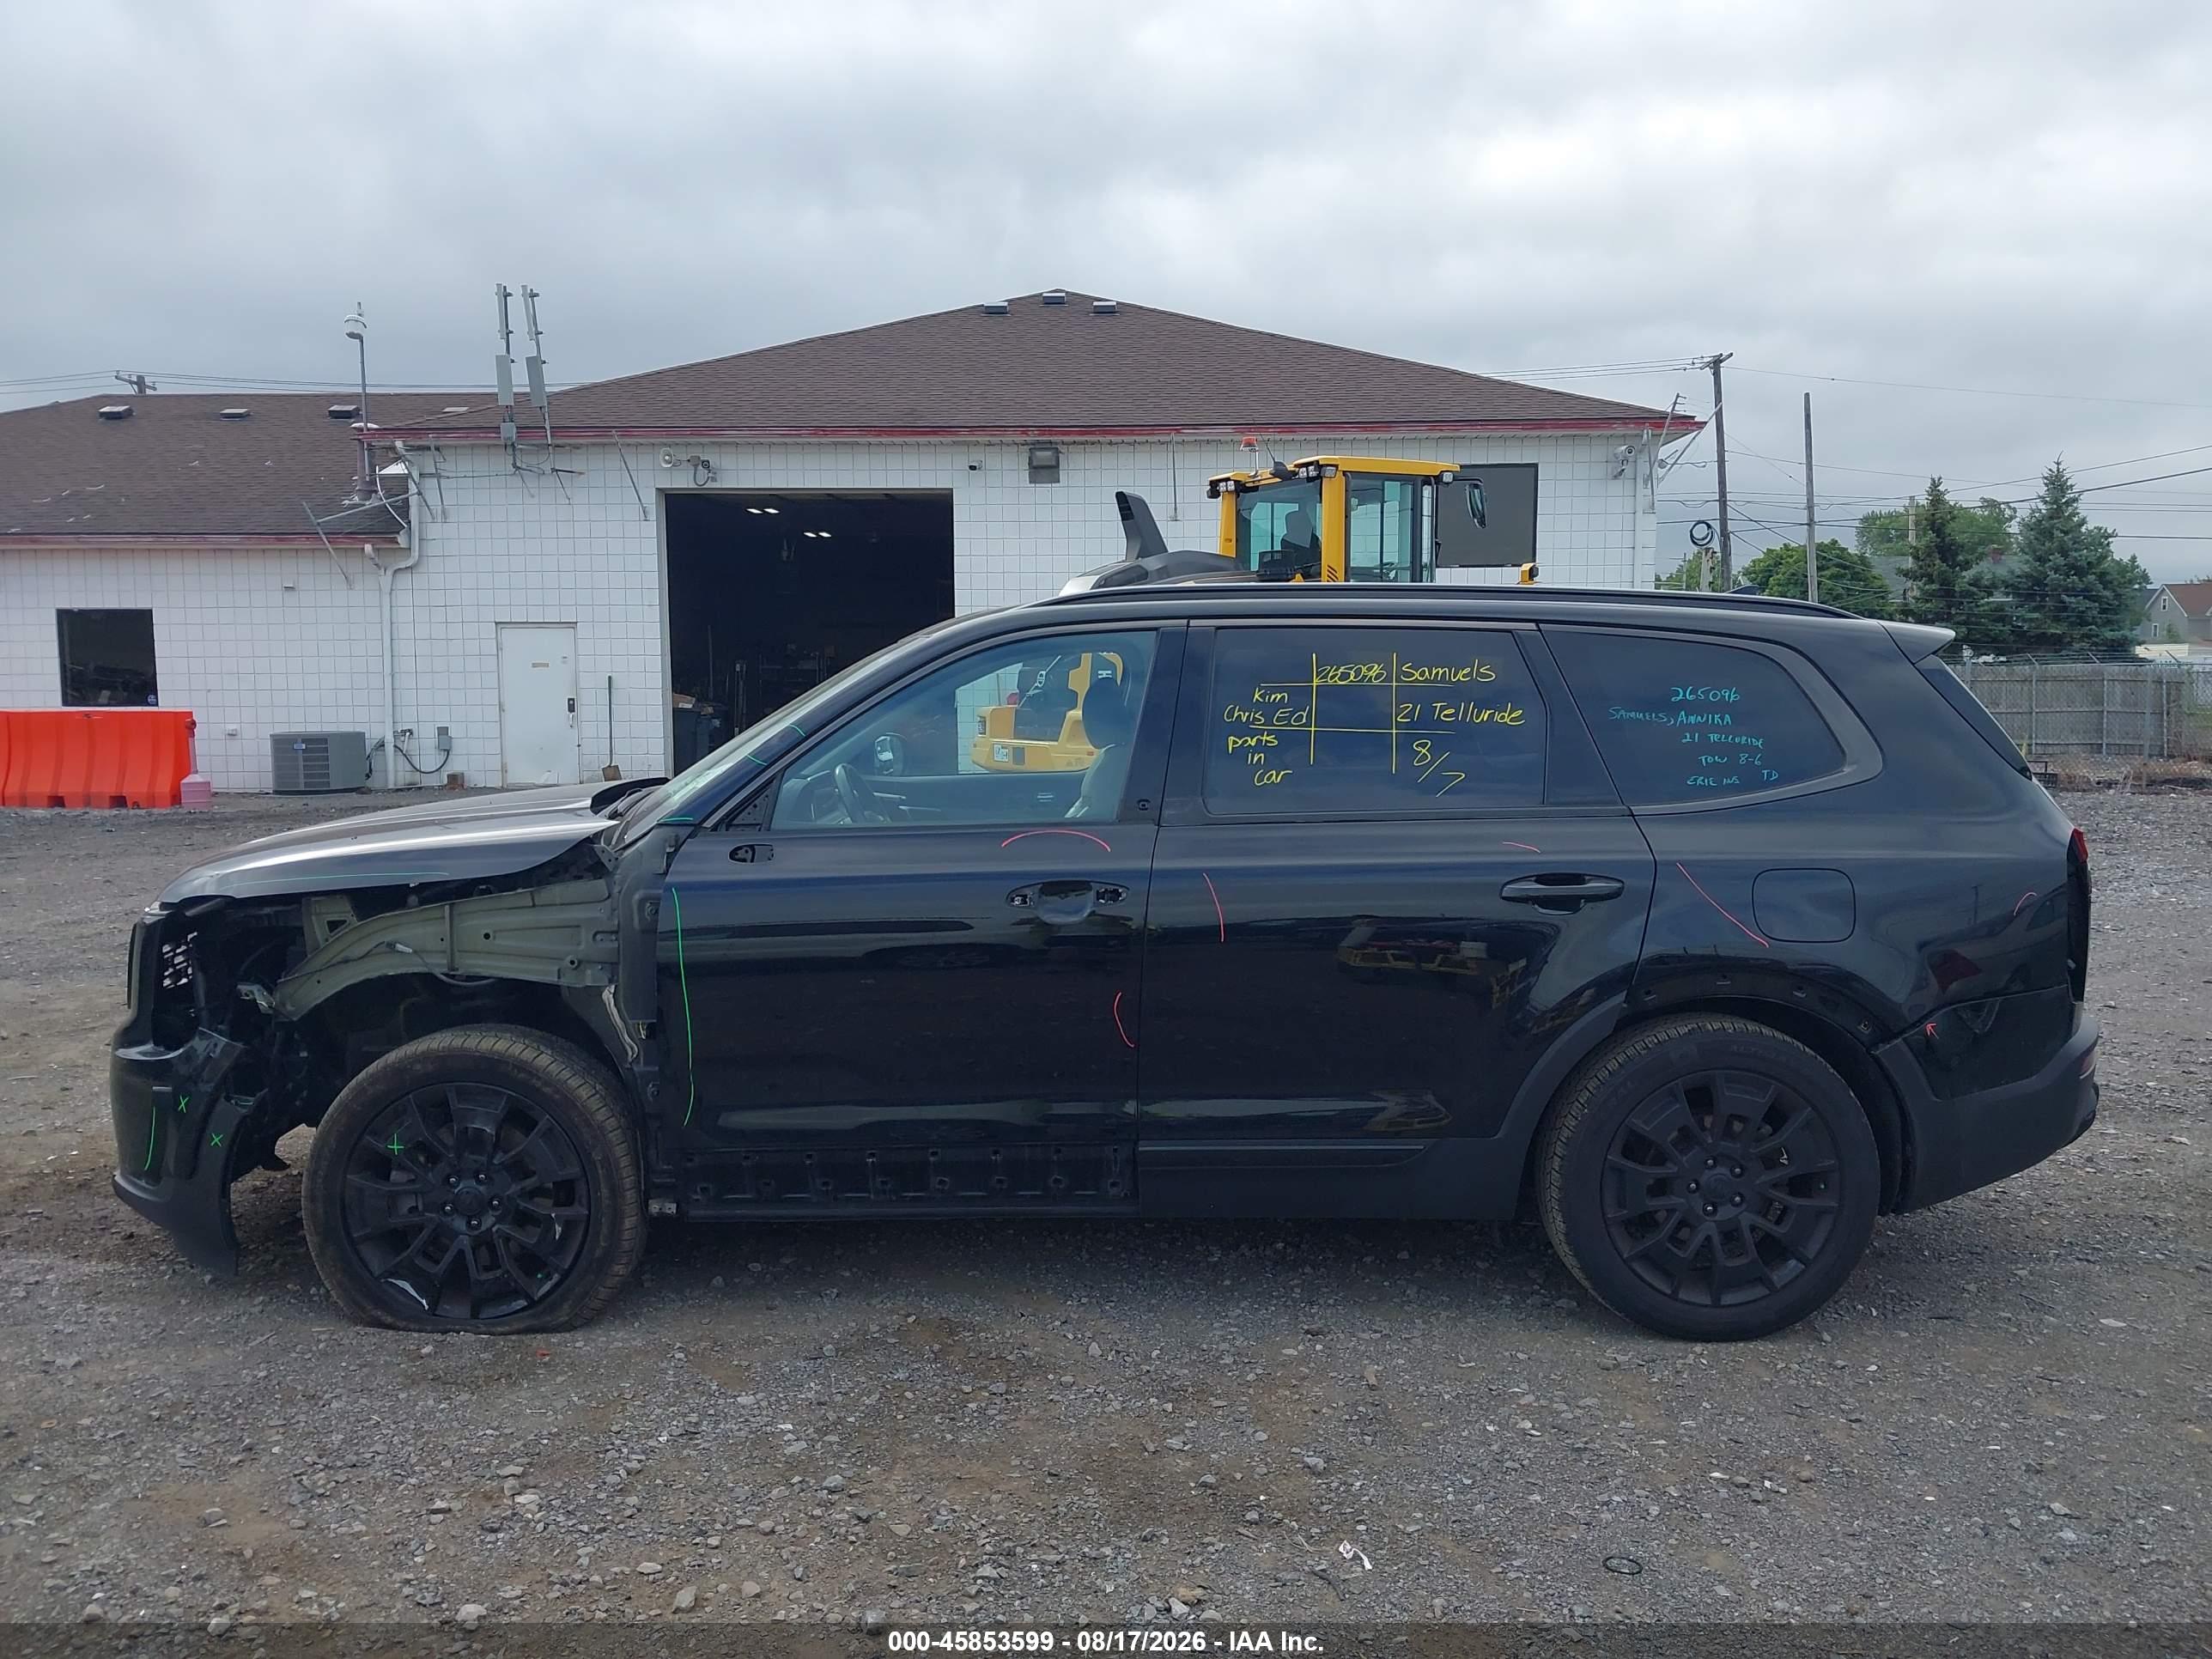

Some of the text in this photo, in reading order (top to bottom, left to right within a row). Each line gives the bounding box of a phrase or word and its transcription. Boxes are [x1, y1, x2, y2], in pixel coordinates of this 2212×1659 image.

[1400, 659, 1497, 683] Samuels
[1670, 686, 1741, 703] 265096
[1223, 704, 1310, 726] Chris Ed
[1396, 701, 1526, 726] 21 Telluride
[1227, 730, 1279, 755] parts
[1681, 732, 1699, 744] 21
[1247, 749, 1266, 766] in
[1739, 753, 1762, 766] 8-6
[1254, 769, 1294, 787] car
